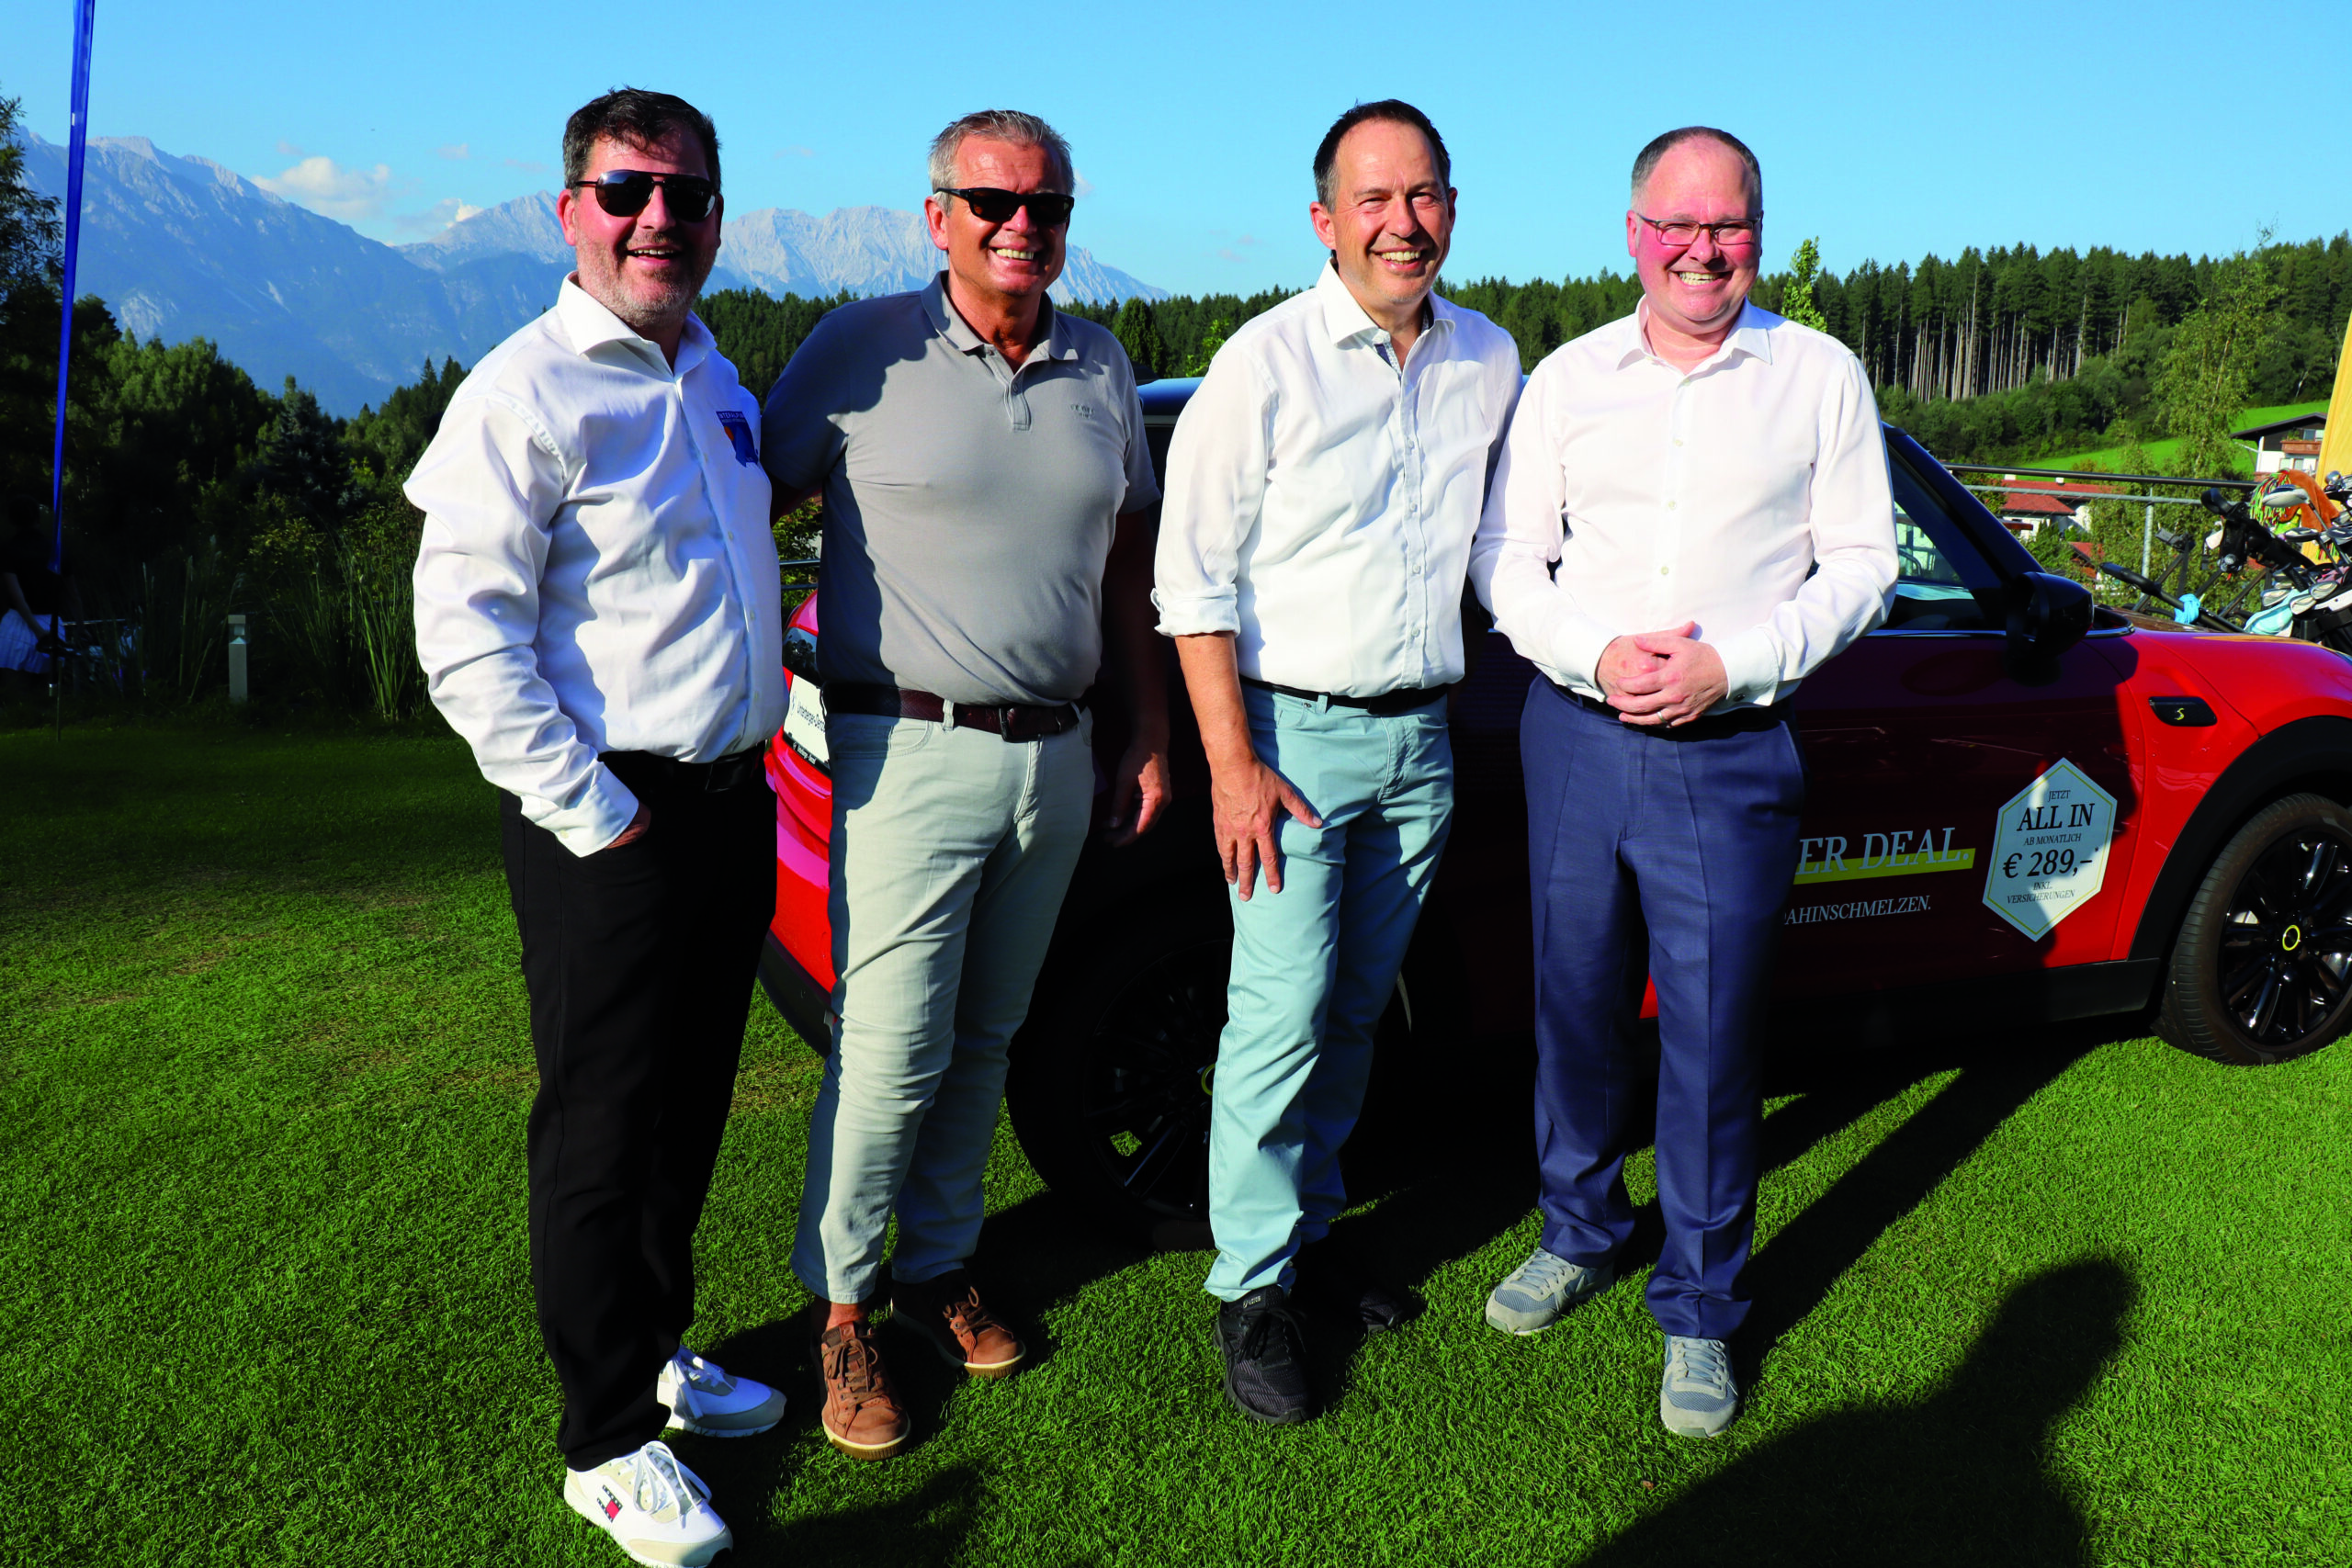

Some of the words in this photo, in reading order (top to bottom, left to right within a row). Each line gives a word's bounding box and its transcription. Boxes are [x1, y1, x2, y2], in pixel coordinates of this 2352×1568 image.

[2175, 707, 2184, 720] S
[2048, 790, 2071, 803] JETZT
[2017, 806, 2061, 831] ALL
[2068, 803, 2095, 829] IN
[2024, 837, 2037, 846] AB
[2037, 832, 2083, 846] MONATLICH
[1859, 828, 1970, 870] DEAL.
[2002, 852, 2023, 879] €
[2033, 881, 2053, 891] INKL.
[2007, 890, 2076, 905] VERSICHERUNGEN
[1784, 895, 1932, 926] AHINSCHMELZEN.
